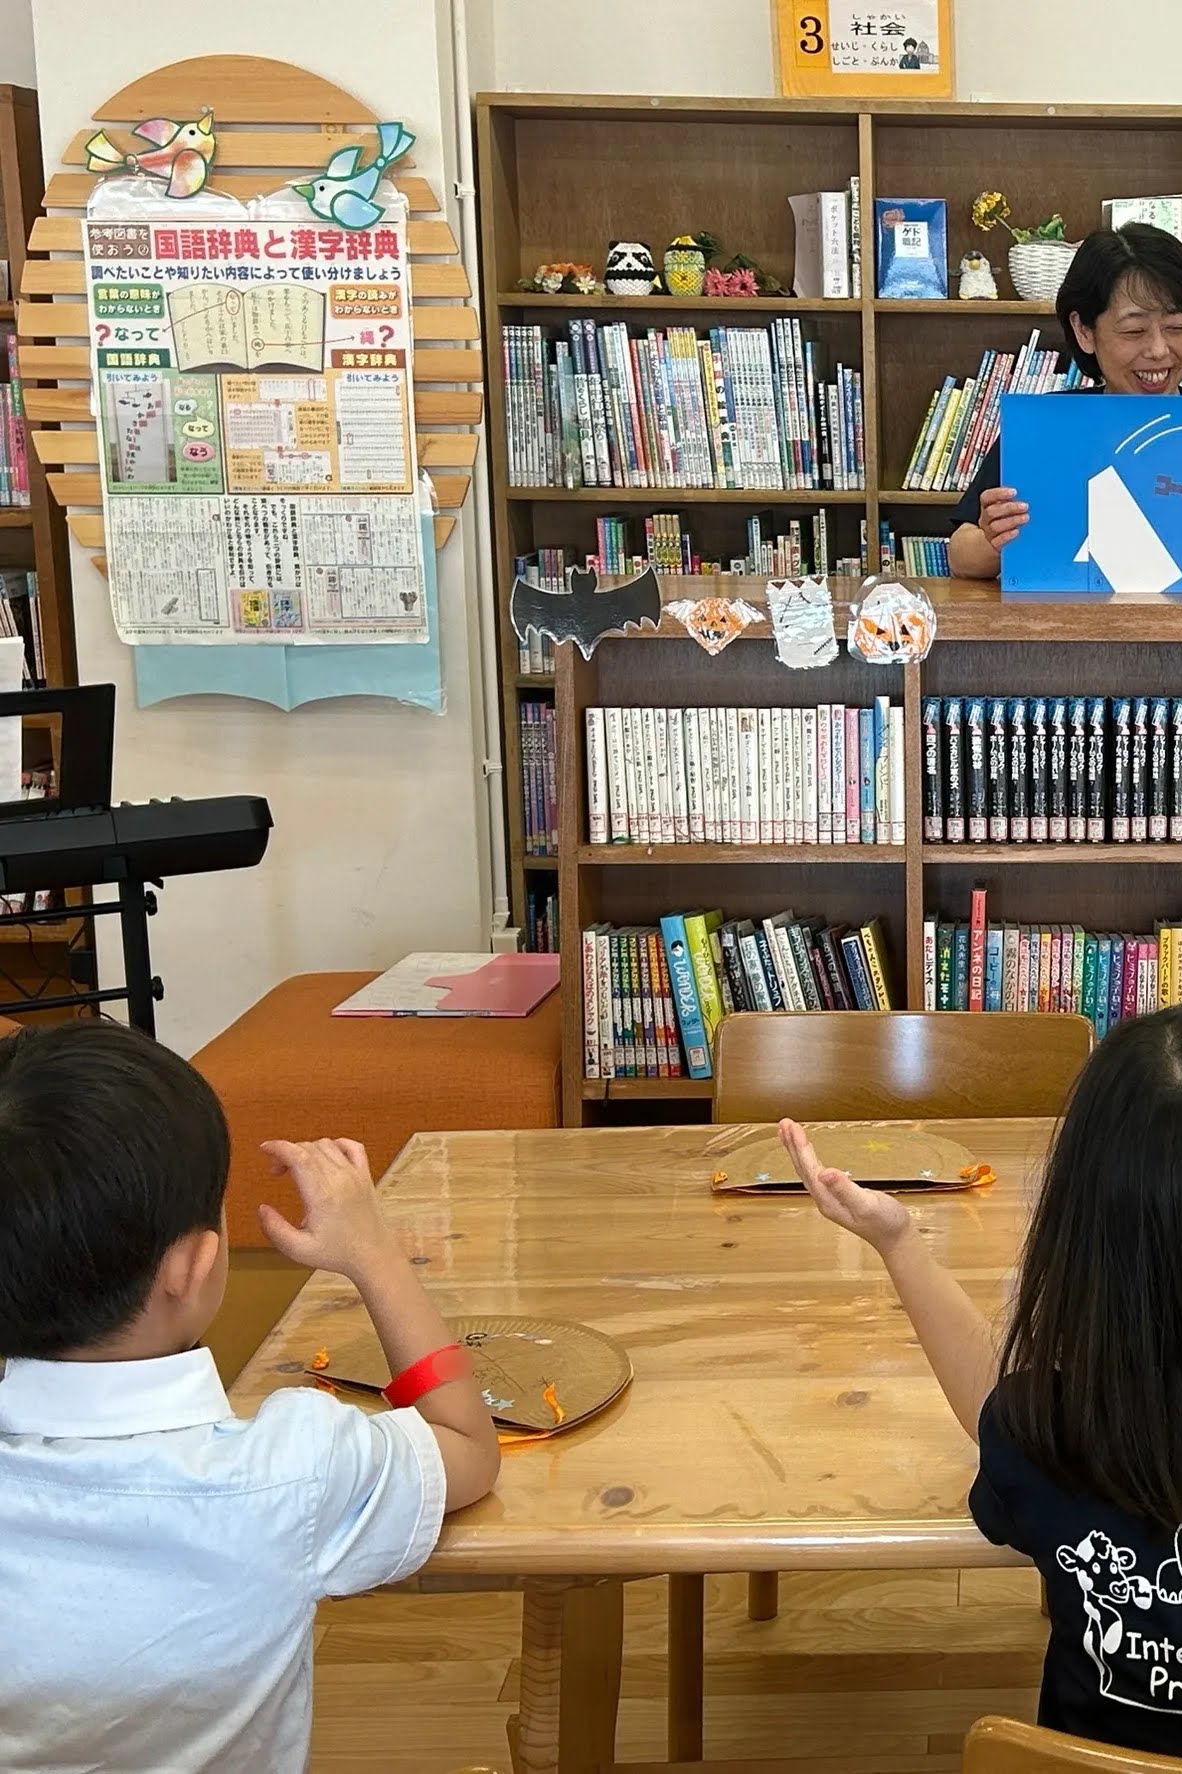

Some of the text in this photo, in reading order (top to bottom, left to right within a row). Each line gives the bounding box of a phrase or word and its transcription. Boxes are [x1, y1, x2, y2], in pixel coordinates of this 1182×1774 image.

[800, 16, 824, 54] 3
[850, 21, 906, 36] 社会
[831, 41, 898, 51] せいじ・くらし
[832, 56, 898, 66] しごと・ぶんか
[89, 227, 148, 240] 参考図書を
[902, 227, 921, 237] ゲド
[153, 229, 401, 261] 国語辞典と漢字辞典
[902, 237, 921, 247] 戦記
[90, 265, 402, 281] 調べたいことや知りたい内容によって使い分けましょう
[97, 288, 160, 301] 言葉の意味が
[335, 288, 397, 301] 漢字の読みが
[98, 304, 161, 315] わからないとき
[334, 304, 399, 315] わからないとき
[114, 327, 160, 342] なって
[105, 353, 161, 367] 国語辞典
[341, 353, 398, 367] 漢字辞典
[105, 372, 159, 383] 引いてみよう
[346, 373, 400, 383] 引いてみよう
[188, 424, 209, 433] なって
[970, 929, 983, 1000] アンネの日記
[1160, 936, 1170, 996] ブラックバードの歌
